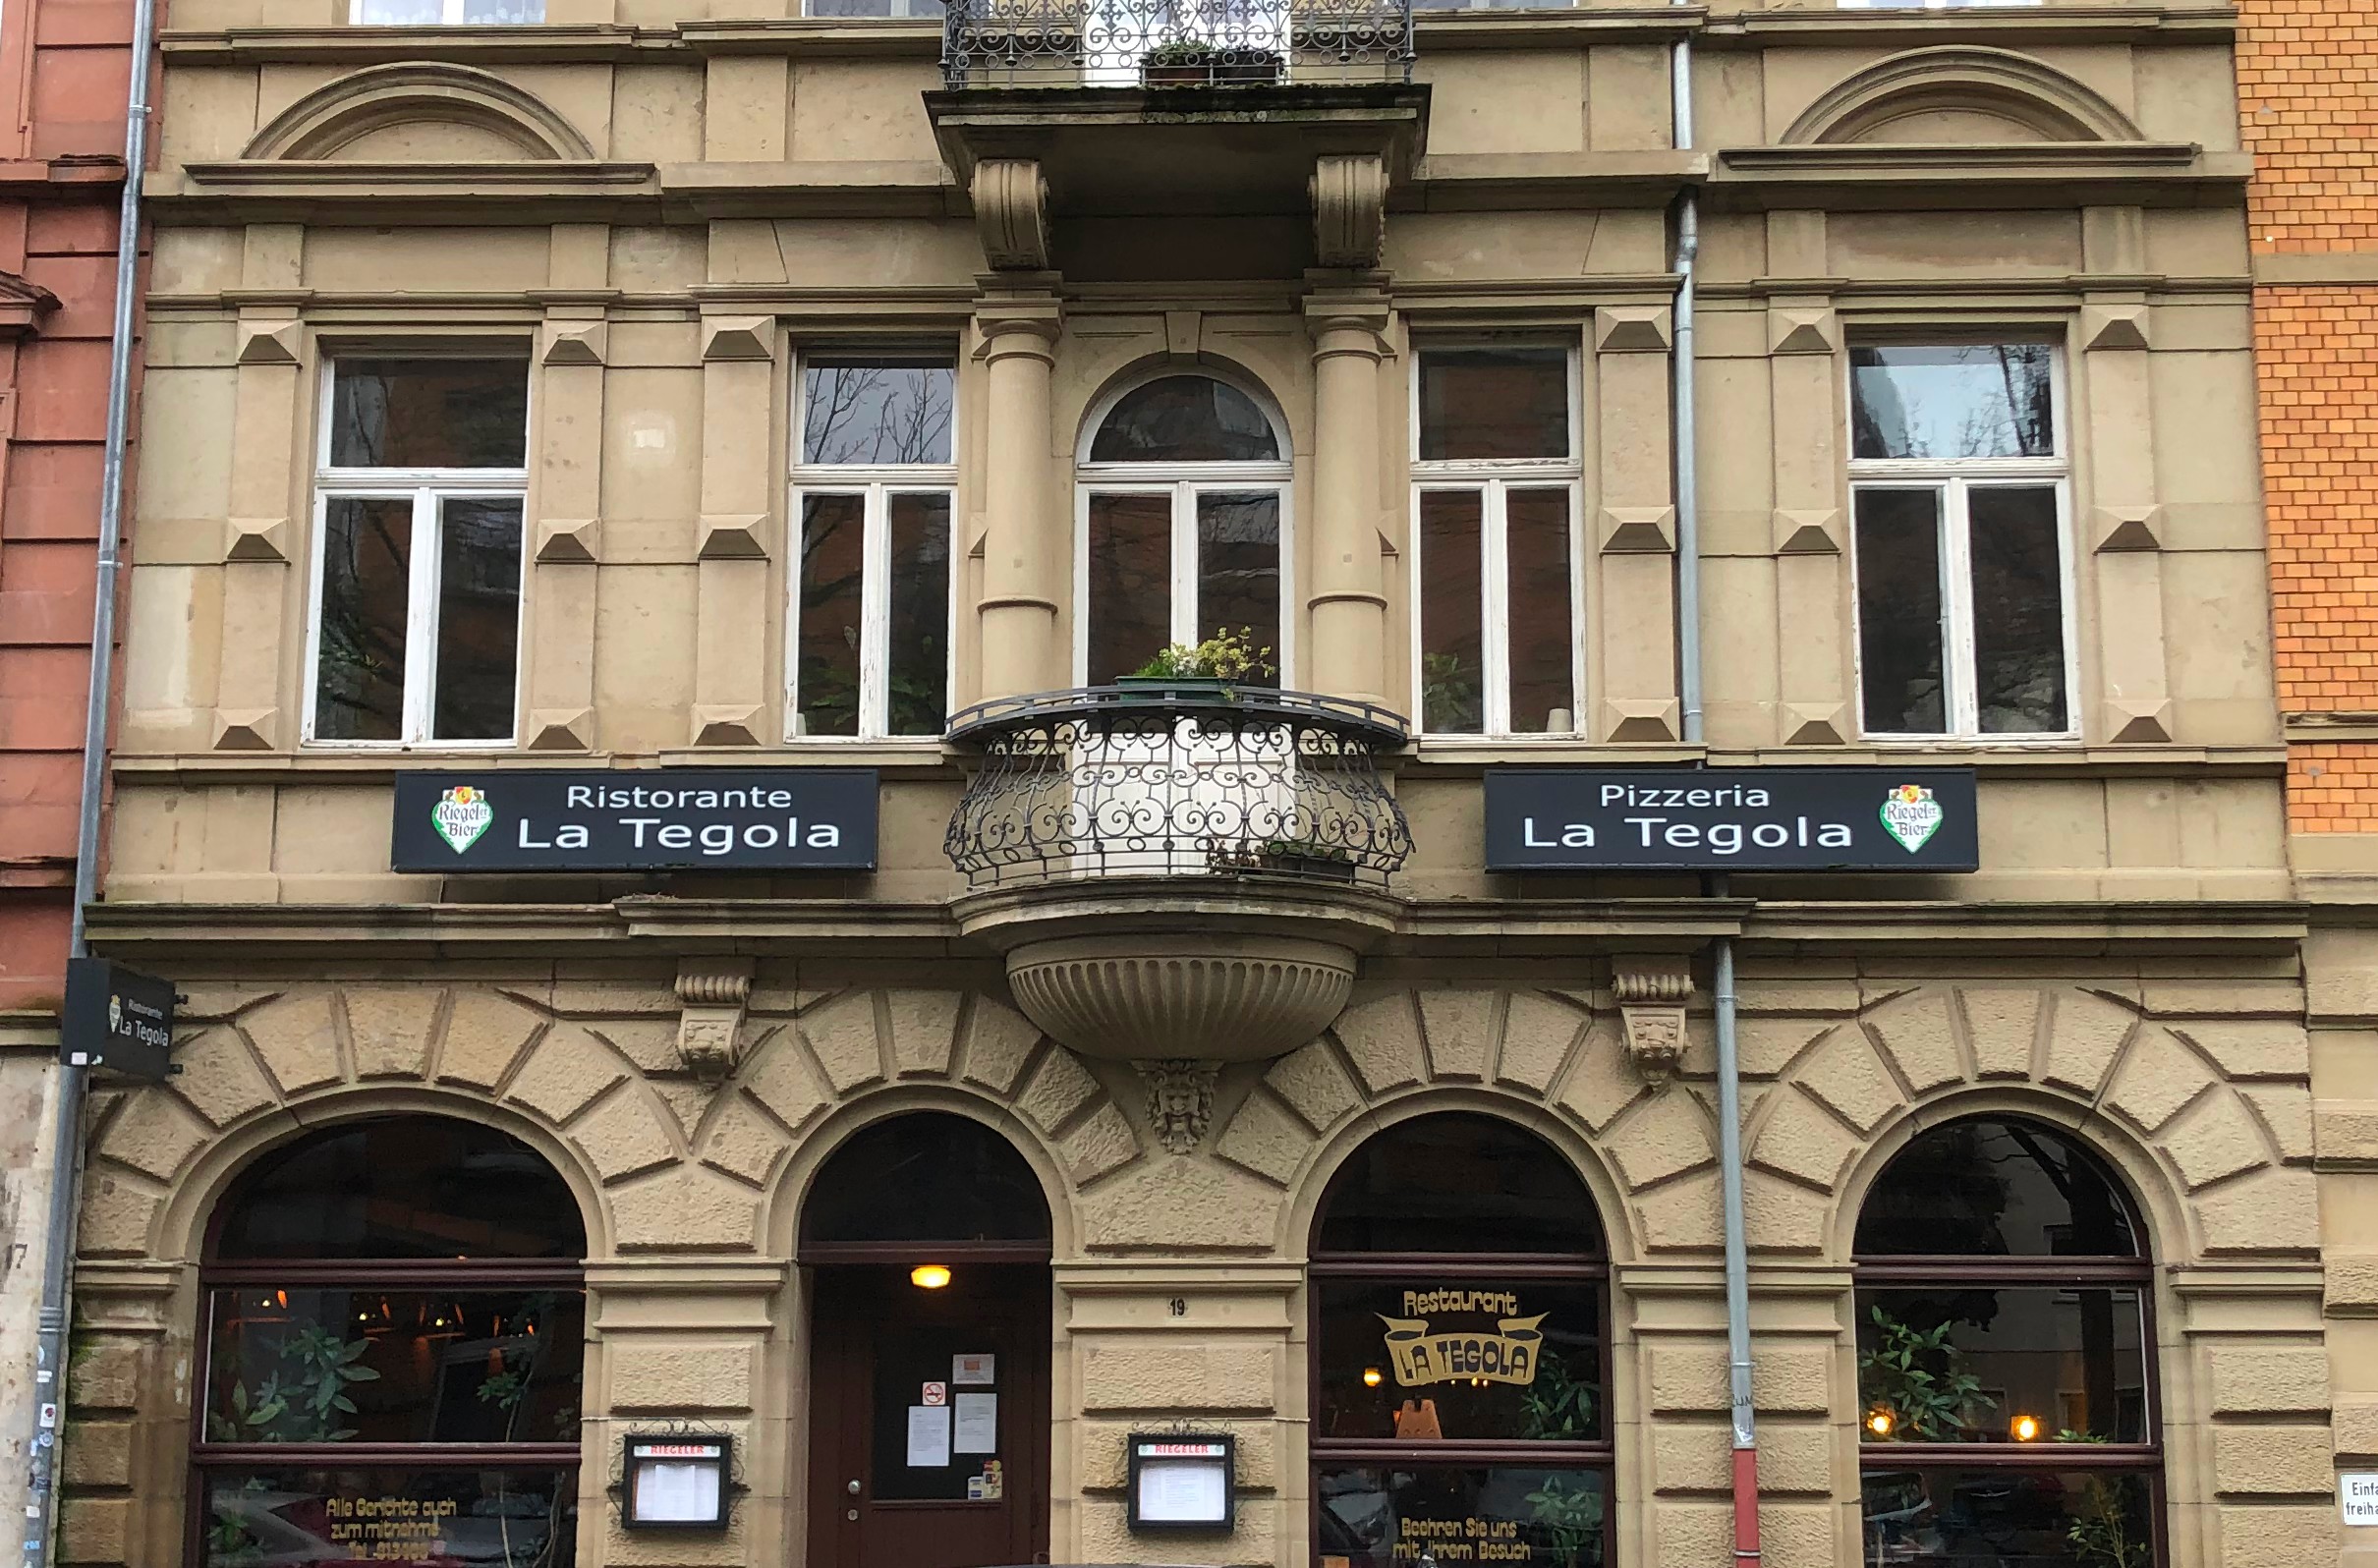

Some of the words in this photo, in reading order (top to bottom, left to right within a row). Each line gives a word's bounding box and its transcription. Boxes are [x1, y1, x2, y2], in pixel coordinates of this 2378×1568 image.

[567, 785, 793, 809] Ristorante
[1600, 784, 1771, 809] Pizzeria
[445, 821, 480, 837] Bier
[518, 817, 590, 849] La
[618, 816, 840, 856] Tegola
[1524, 817, 1596, 848] La
[1623, 816, 1853, 855] Tegola
[1895, 821, 1929, 837] Bier
[119, 1015, 133, 1036] La
[135, 1019, 169, 1047] Tegola
[1168, 1298, 1186, 1316] 19
[1403, 1287, 1518, 1316] Restaurant
[1398, 1344, 1433, 1380] LA
[1436, 1339, 1529, 1379] TEGOLA
[651, 1445, 705, 1454] RIEGELER
[1155, 1444, 1209, 1454] RIEGELER
[330, 1523, 363, 1540] zum
[1465, 1517, 1488, 1538] Sie
[1490, 1521, 1518, 1539] uns
[1392, 1538, 1421, 1559] mit
[1478, 1540, 1531, 1560] Besuch
